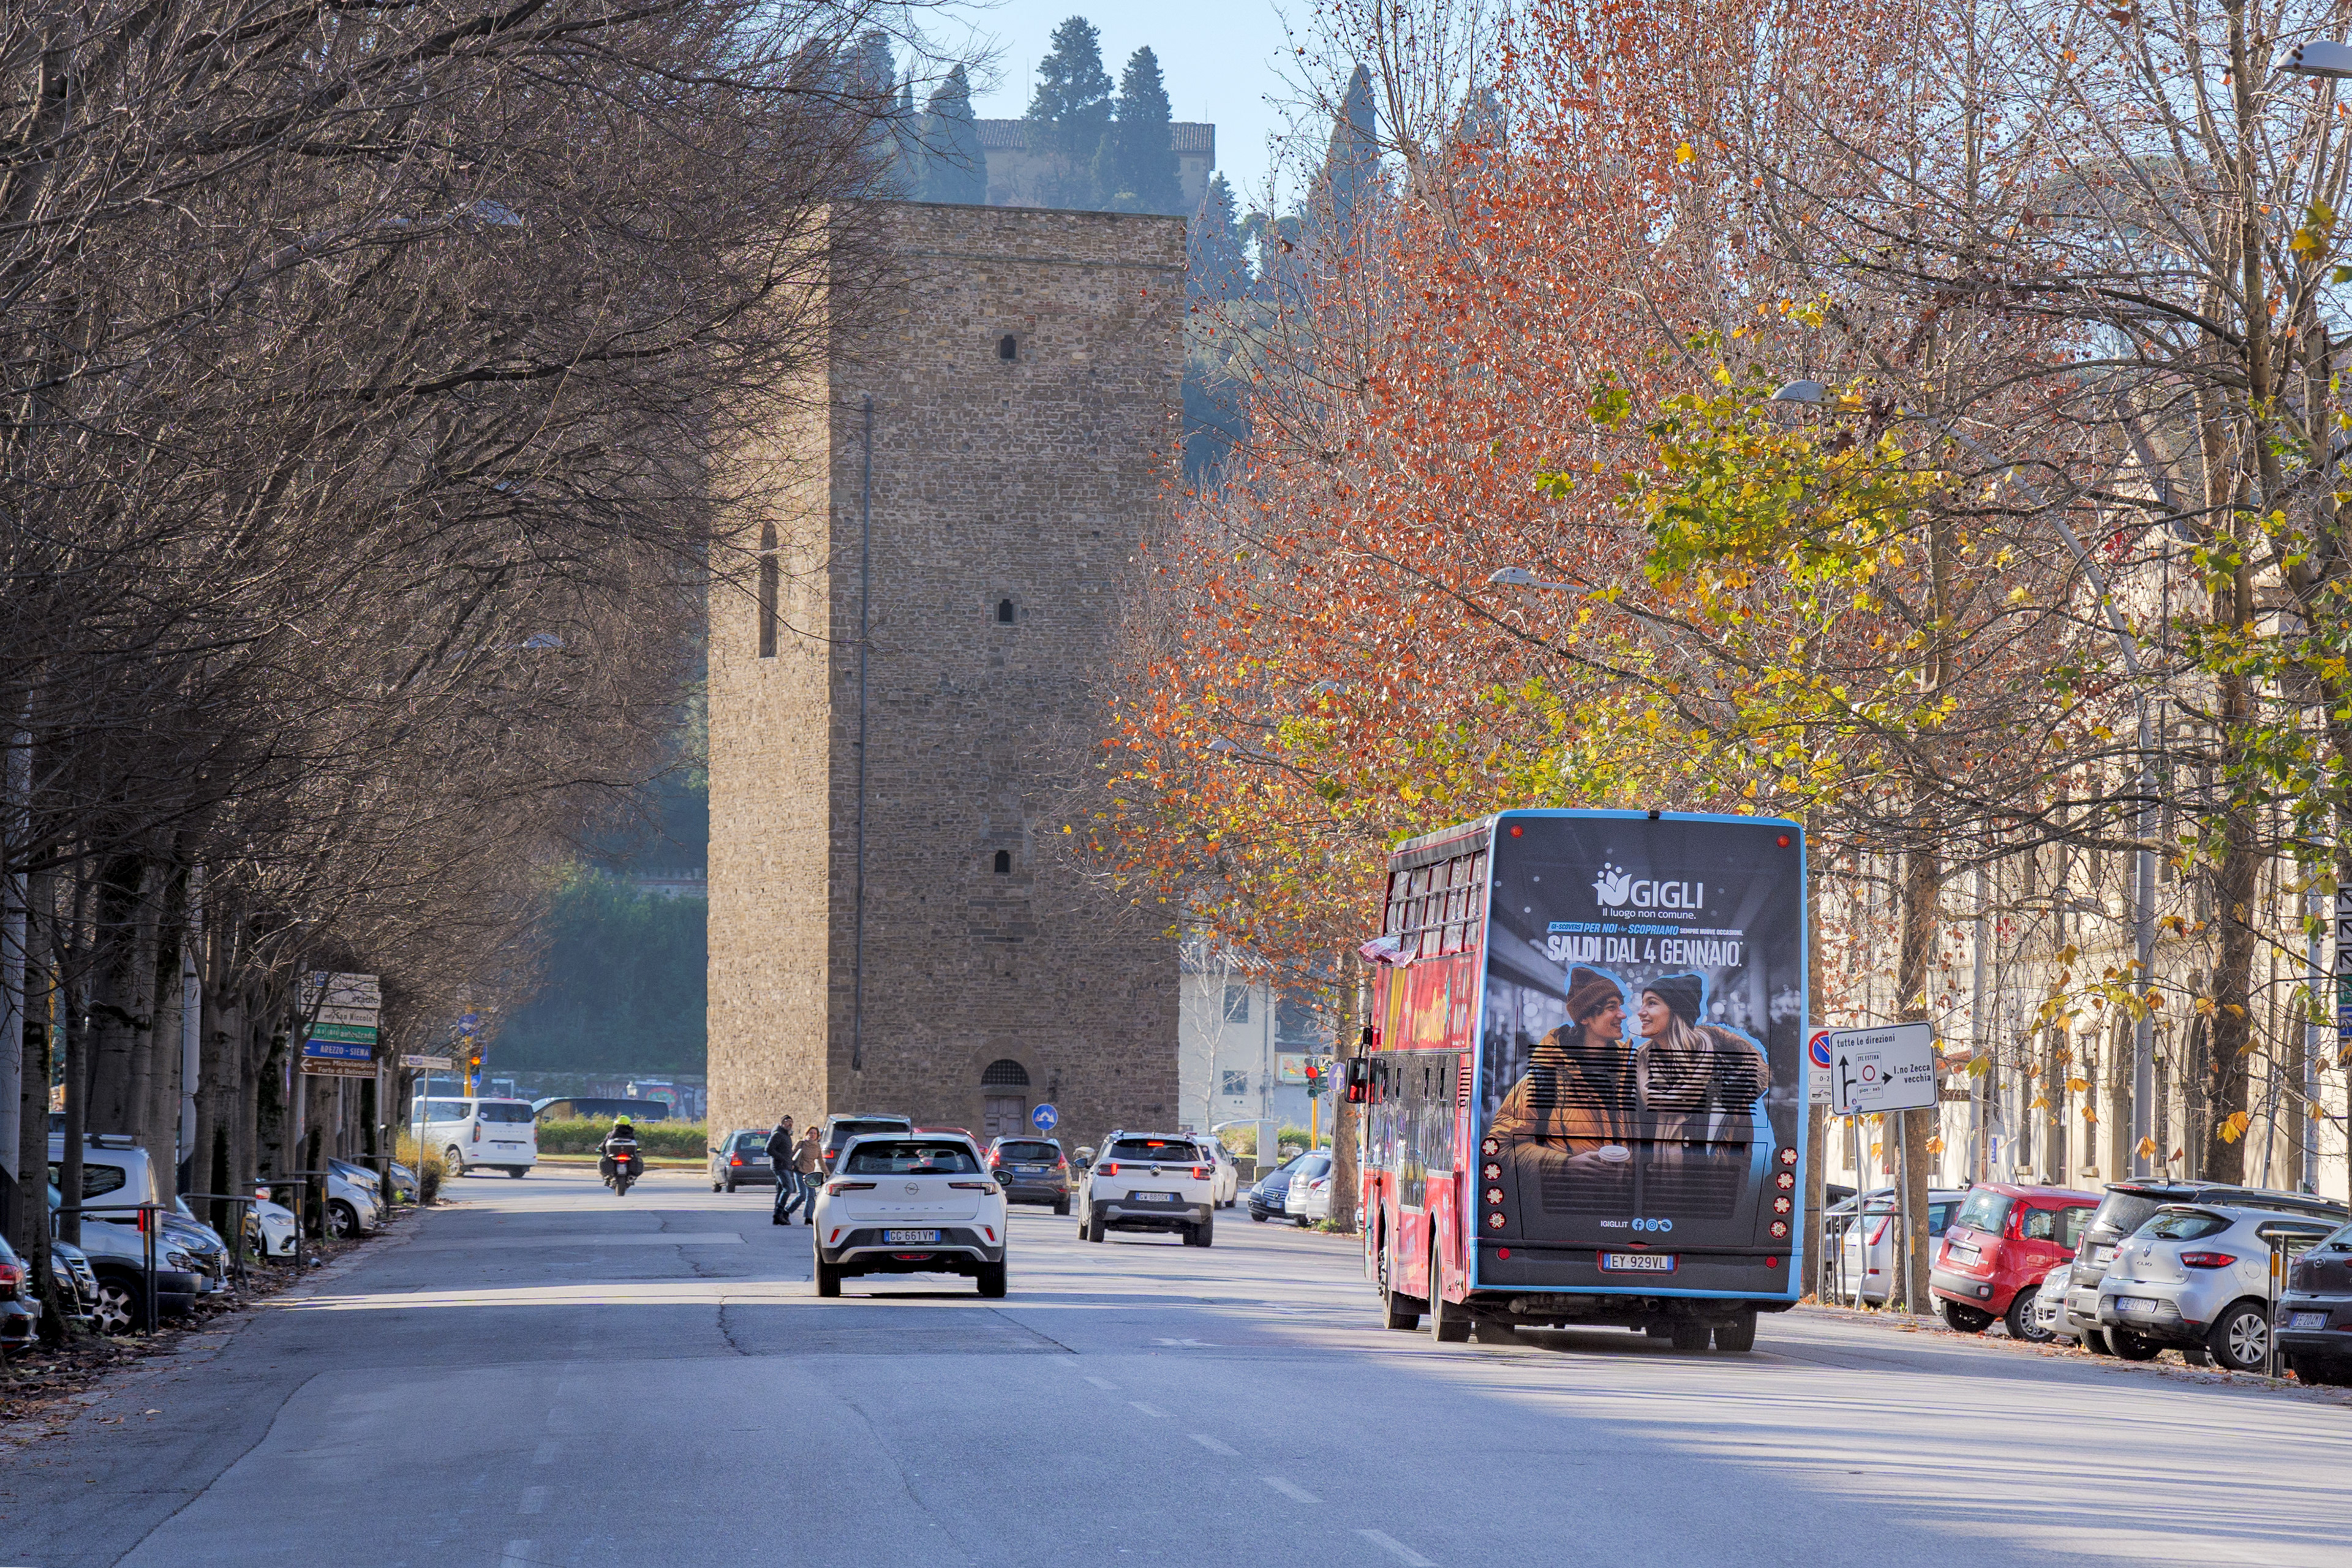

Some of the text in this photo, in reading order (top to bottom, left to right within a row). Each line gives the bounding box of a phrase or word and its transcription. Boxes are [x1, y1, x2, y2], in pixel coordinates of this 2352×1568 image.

[1630, 880, 1703, 909] GIGLI
[1602, 908, 1608, 916] Il
[1610, 908, 1636, 919] luogo
[1657, 910, 1697, 919] comune.
[1583, 922, 1600, 933] PER
[1602, 924, 1618, 933] NOI
[1627, 924, 1679, 935] SCOPRIAMO
[1547, 935, 1601, 962] SALDI
[1605, 937, 1640, 963] DAL
[1643, 938, 1656, 963] 4
[1837, 1033, 1896, 1048] tutte le direzioni
[320, 1045, 344, 1054] AREZZO
[350, 1048, 369, 1057] SIENA
[1910, 1064, 1931, 1072] Zecca
[1904, 1072, 1931, 1084] vecchia
[890, 1231, 935, 1241] GG 661VM
[1611, 1256, 1625, 1267] EY
[1630, 1256, 1665, 1268] 929VL
